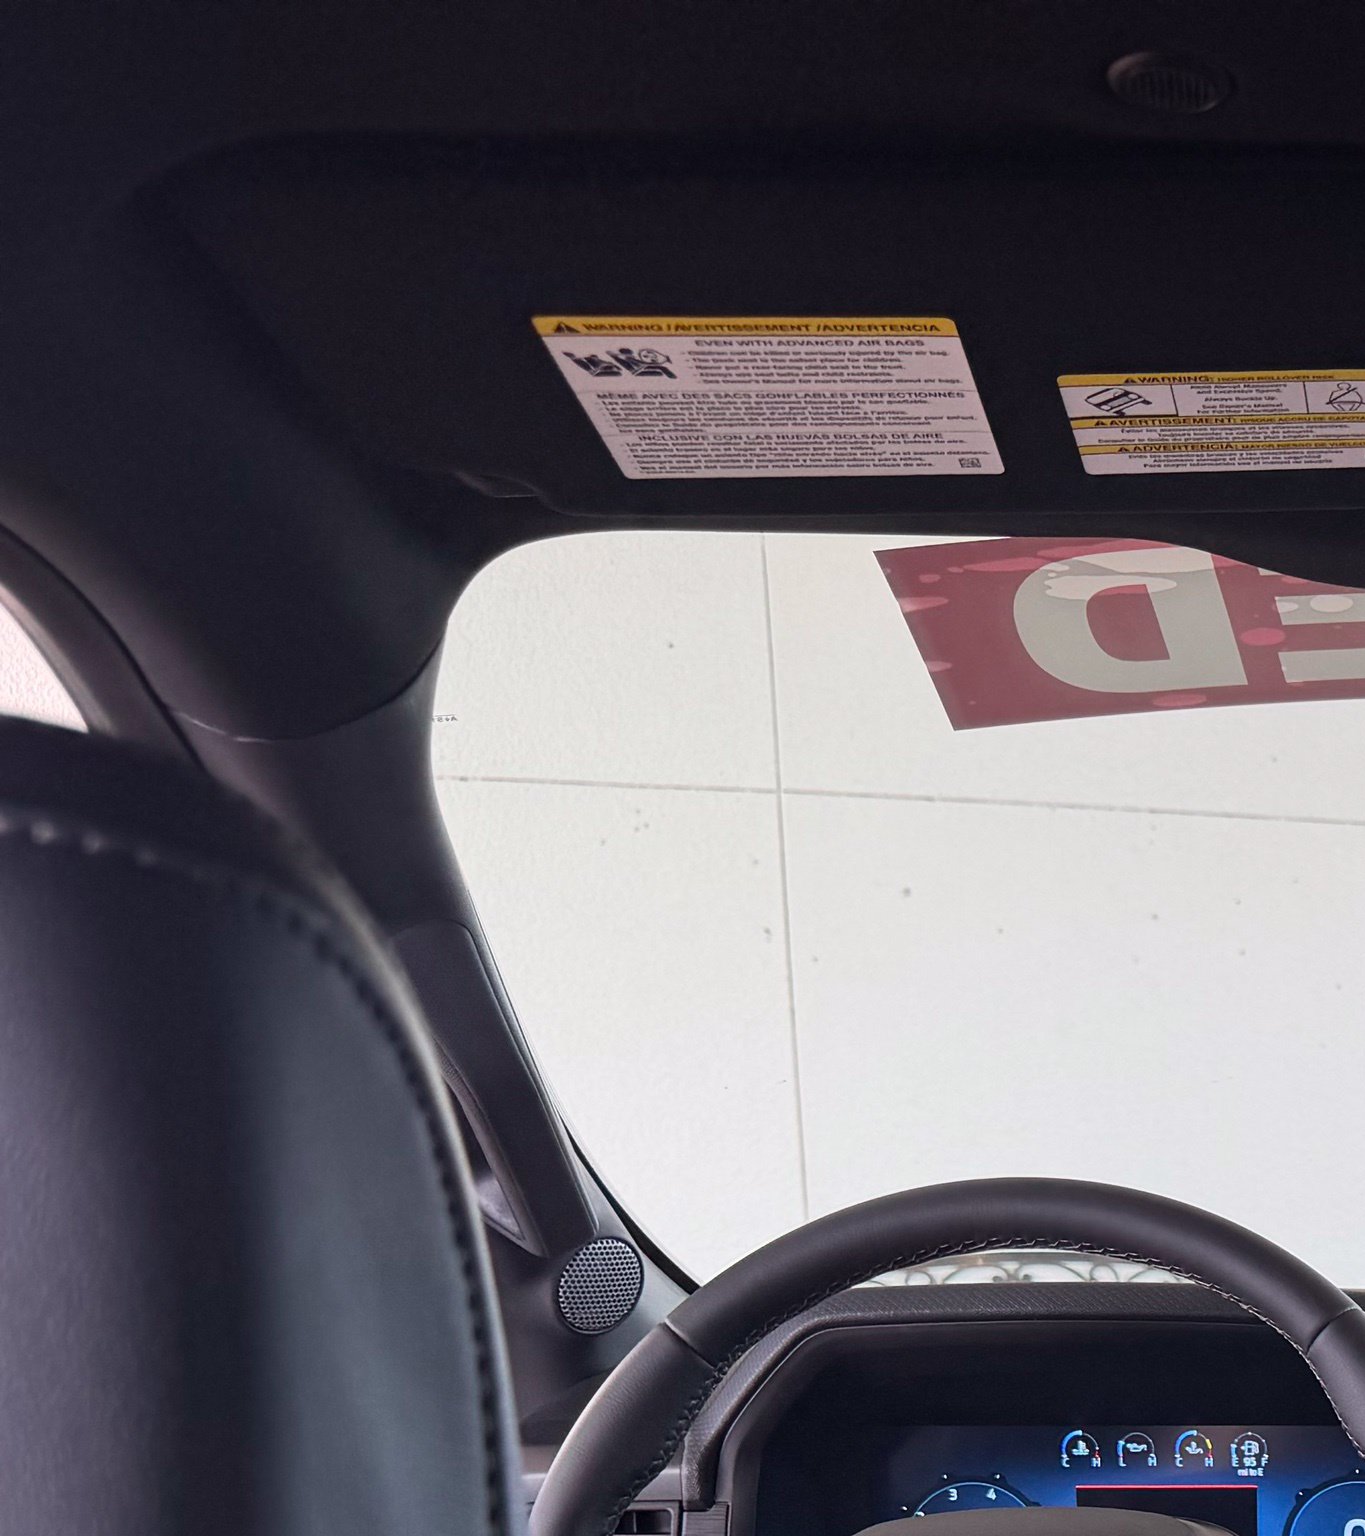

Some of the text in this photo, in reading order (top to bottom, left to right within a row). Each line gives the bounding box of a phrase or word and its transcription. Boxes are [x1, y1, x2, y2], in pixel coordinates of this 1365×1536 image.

[583, 323, 663, 332] WARNING
[675, 323, 810, 332] AVERTISSEMENT
[694, 339, 925, 347] EVEN WITH ADVANCED AIR BAGS
[642, 392, 679, 400] AVEC
[682, 392, 710, 400] DES
[713, 392, 752, 400] SACS
[755, 391, 848, 400] GONFLABLES
[638, 433, 943, 442] INCLUSIVE CON LAS NUEVAS BOLSAS DE AIRE
[948, 1488, 958, 1501] 3
[986, 1488, 997, 1501] 4
